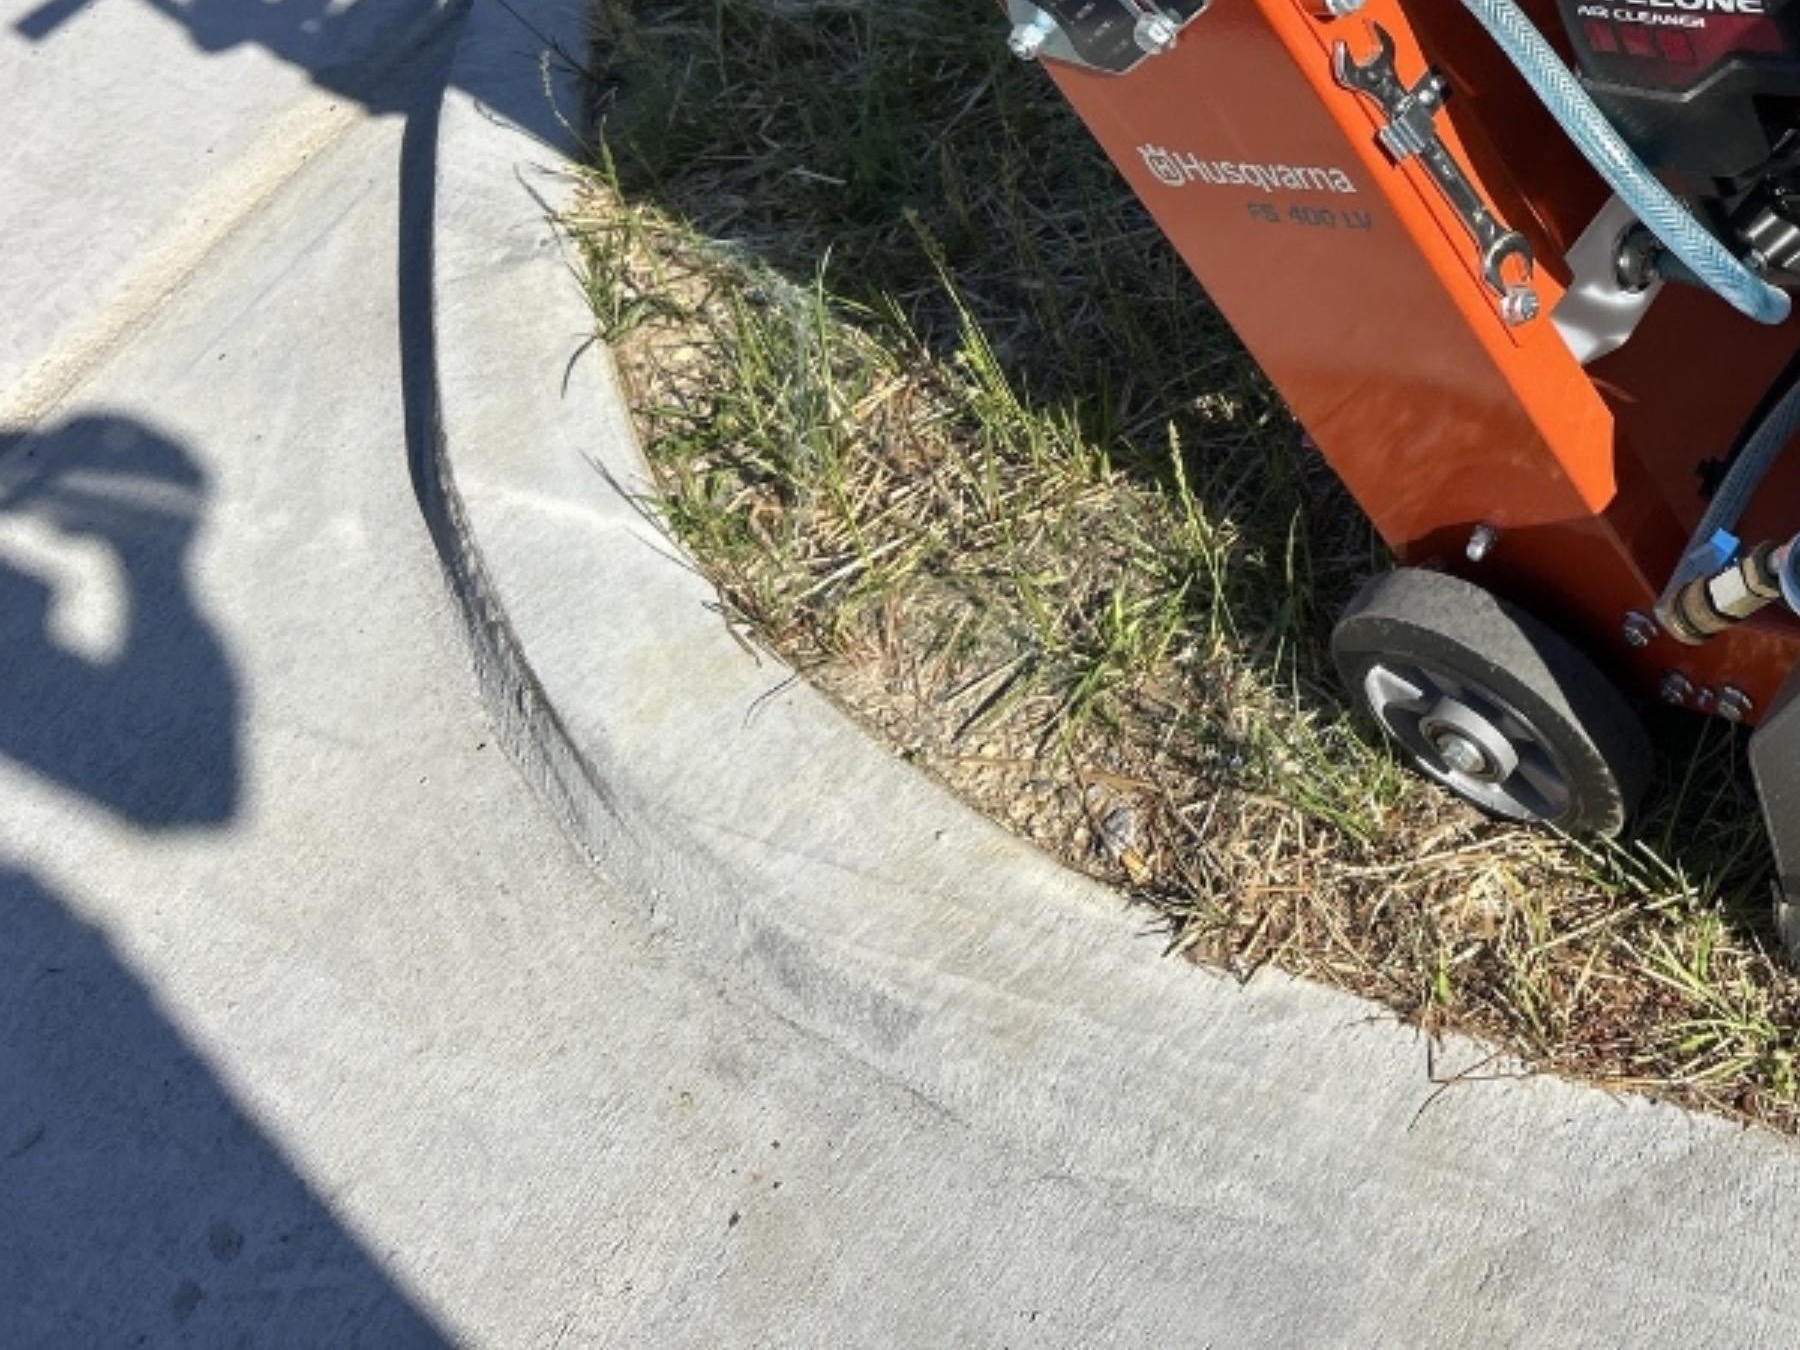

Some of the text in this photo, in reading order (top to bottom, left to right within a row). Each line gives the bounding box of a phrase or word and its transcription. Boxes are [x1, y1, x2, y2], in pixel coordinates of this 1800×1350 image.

[1577, 5, 1706, 29] AIR CLEANER
[1172, 152, 1358, 193] Husqvarna
